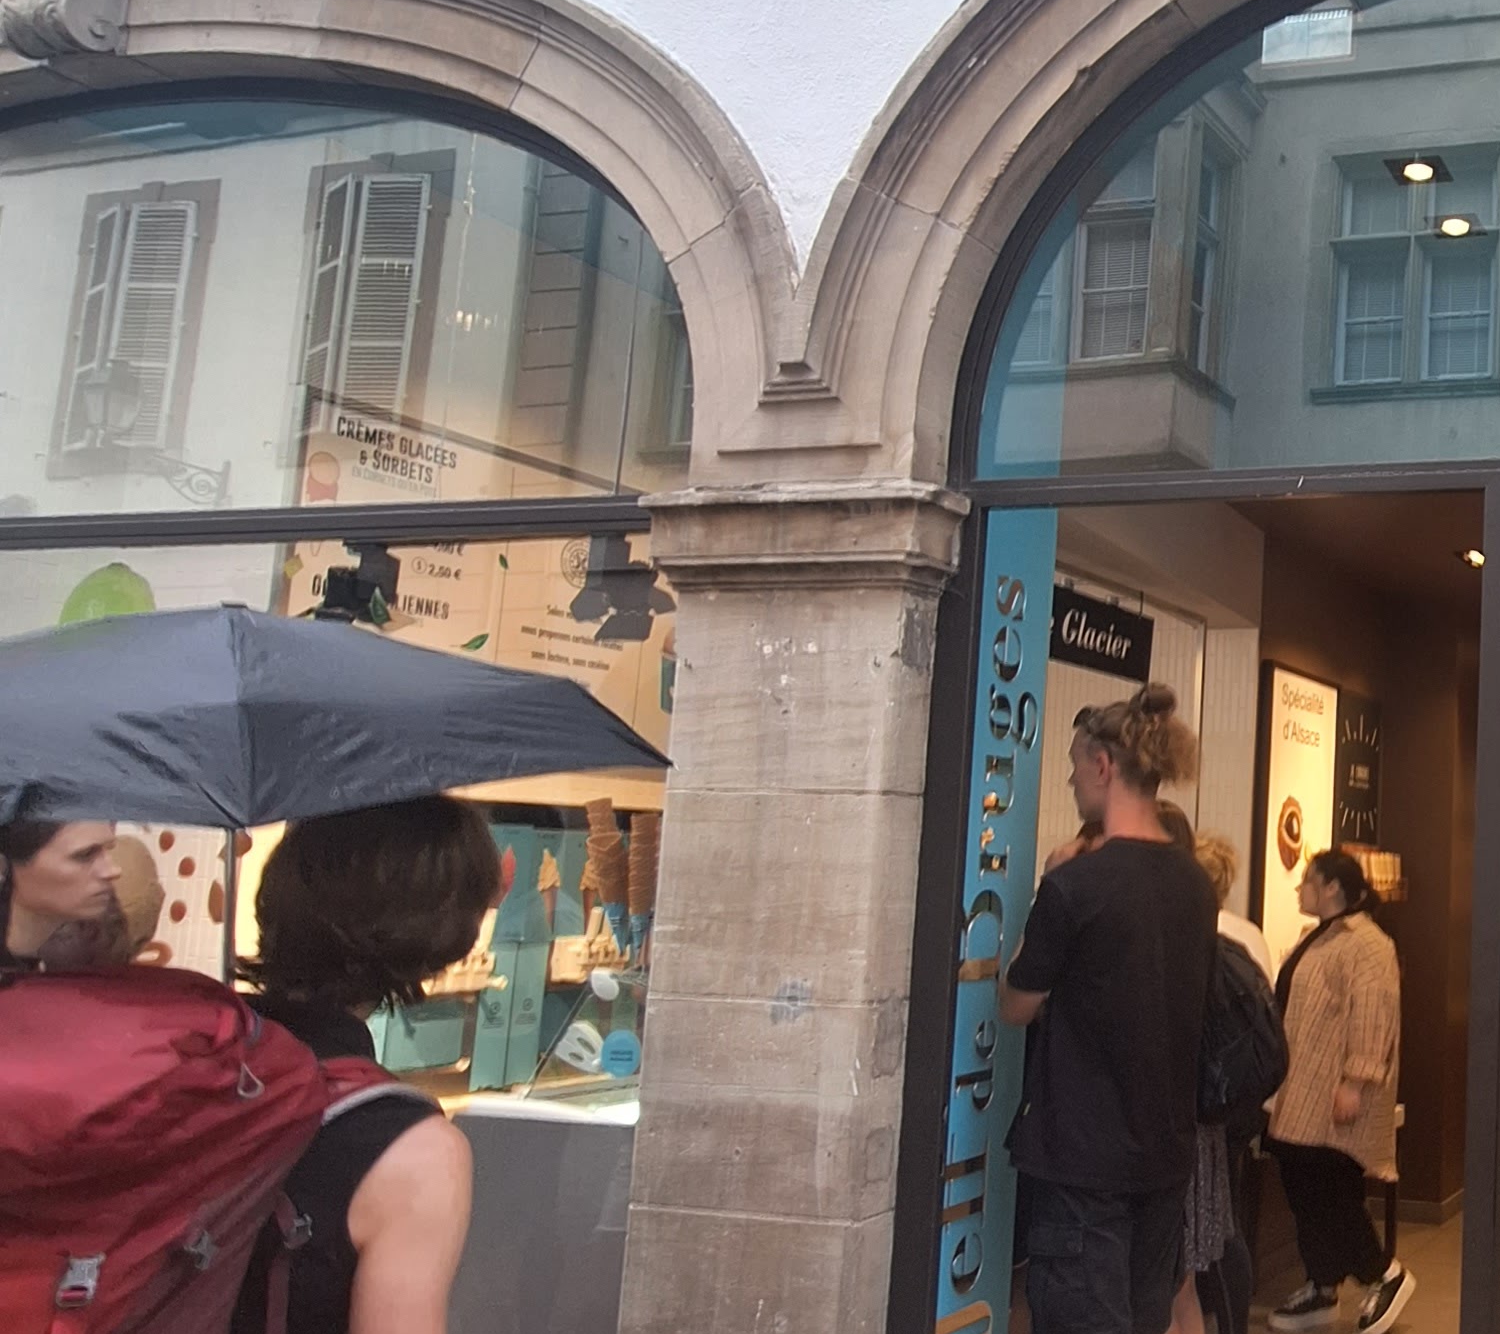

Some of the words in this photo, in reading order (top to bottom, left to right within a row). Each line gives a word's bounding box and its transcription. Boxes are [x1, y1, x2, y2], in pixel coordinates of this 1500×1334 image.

[337, 415, 396, 452] CRÈMES
[400, 435, 457, 469] GLACÉES
[359, 449, 368, 466] &
[372, 451, 433, 484] SORBETS
[1061, 608, 1132, 661] Glacier
[1281, 682, 1325, 716] Spécialité
[1282, 719, 1321, 748] d'Alsace
[957, 575, 1040, 982] Bruges
[954, 1019, 998, 1110] de
